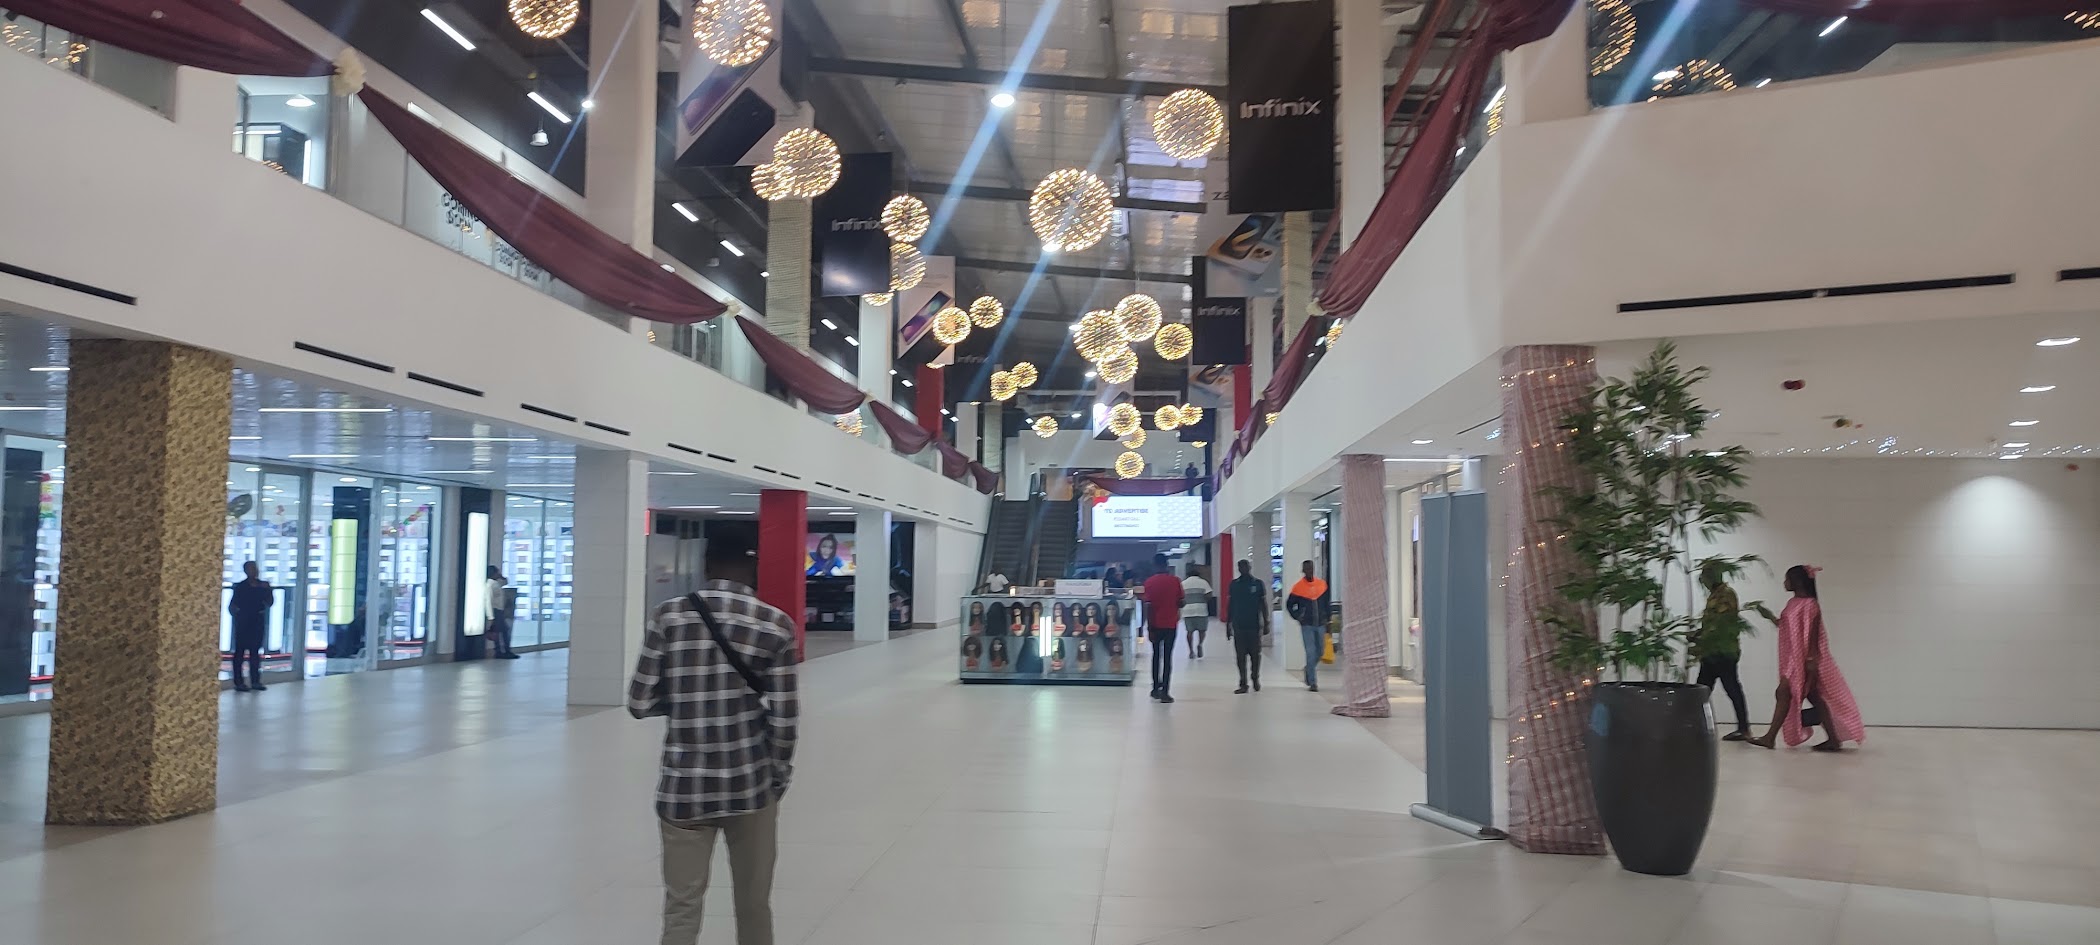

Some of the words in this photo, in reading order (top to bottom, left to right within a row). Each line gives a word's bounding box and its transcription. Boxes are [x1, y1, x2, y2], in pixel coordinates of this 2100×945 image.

[1240, 97, 1321, 118] Infinix
[832, 217, 882, 231] Infinix
[1197, 305, 1240, 316] Infinix
